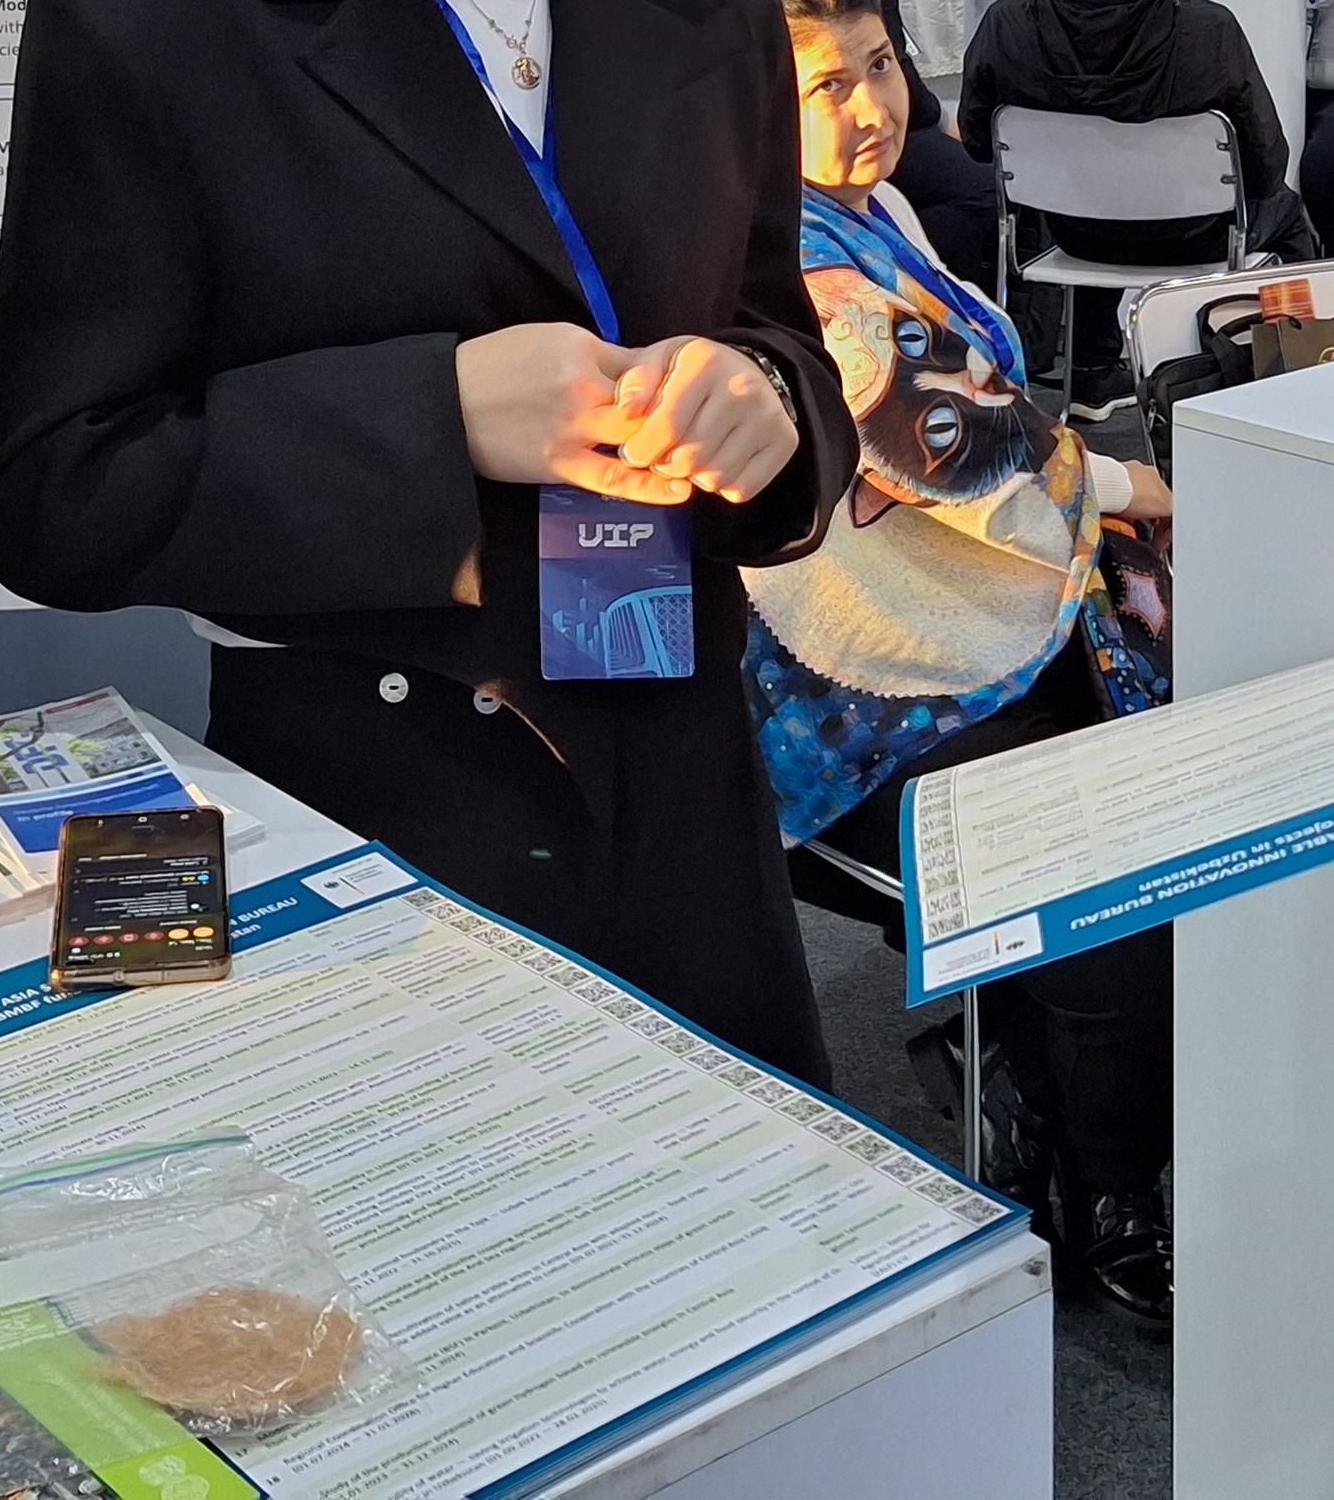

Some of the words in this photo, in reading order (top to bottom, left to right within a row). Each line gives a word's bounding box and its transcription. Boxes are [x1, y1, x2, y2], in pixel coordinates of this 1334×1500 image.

[1250, 841, 1271, 854] in
[1138, 848, 1247, 893] Uzbekistan
[1158, 848, 1287, 901] INNOVATION
[237, 897, 299, 923] BUREAU
[1070, 893, 1154, 931] BUREAU
[0, 988, 40, 1007] ASIA
